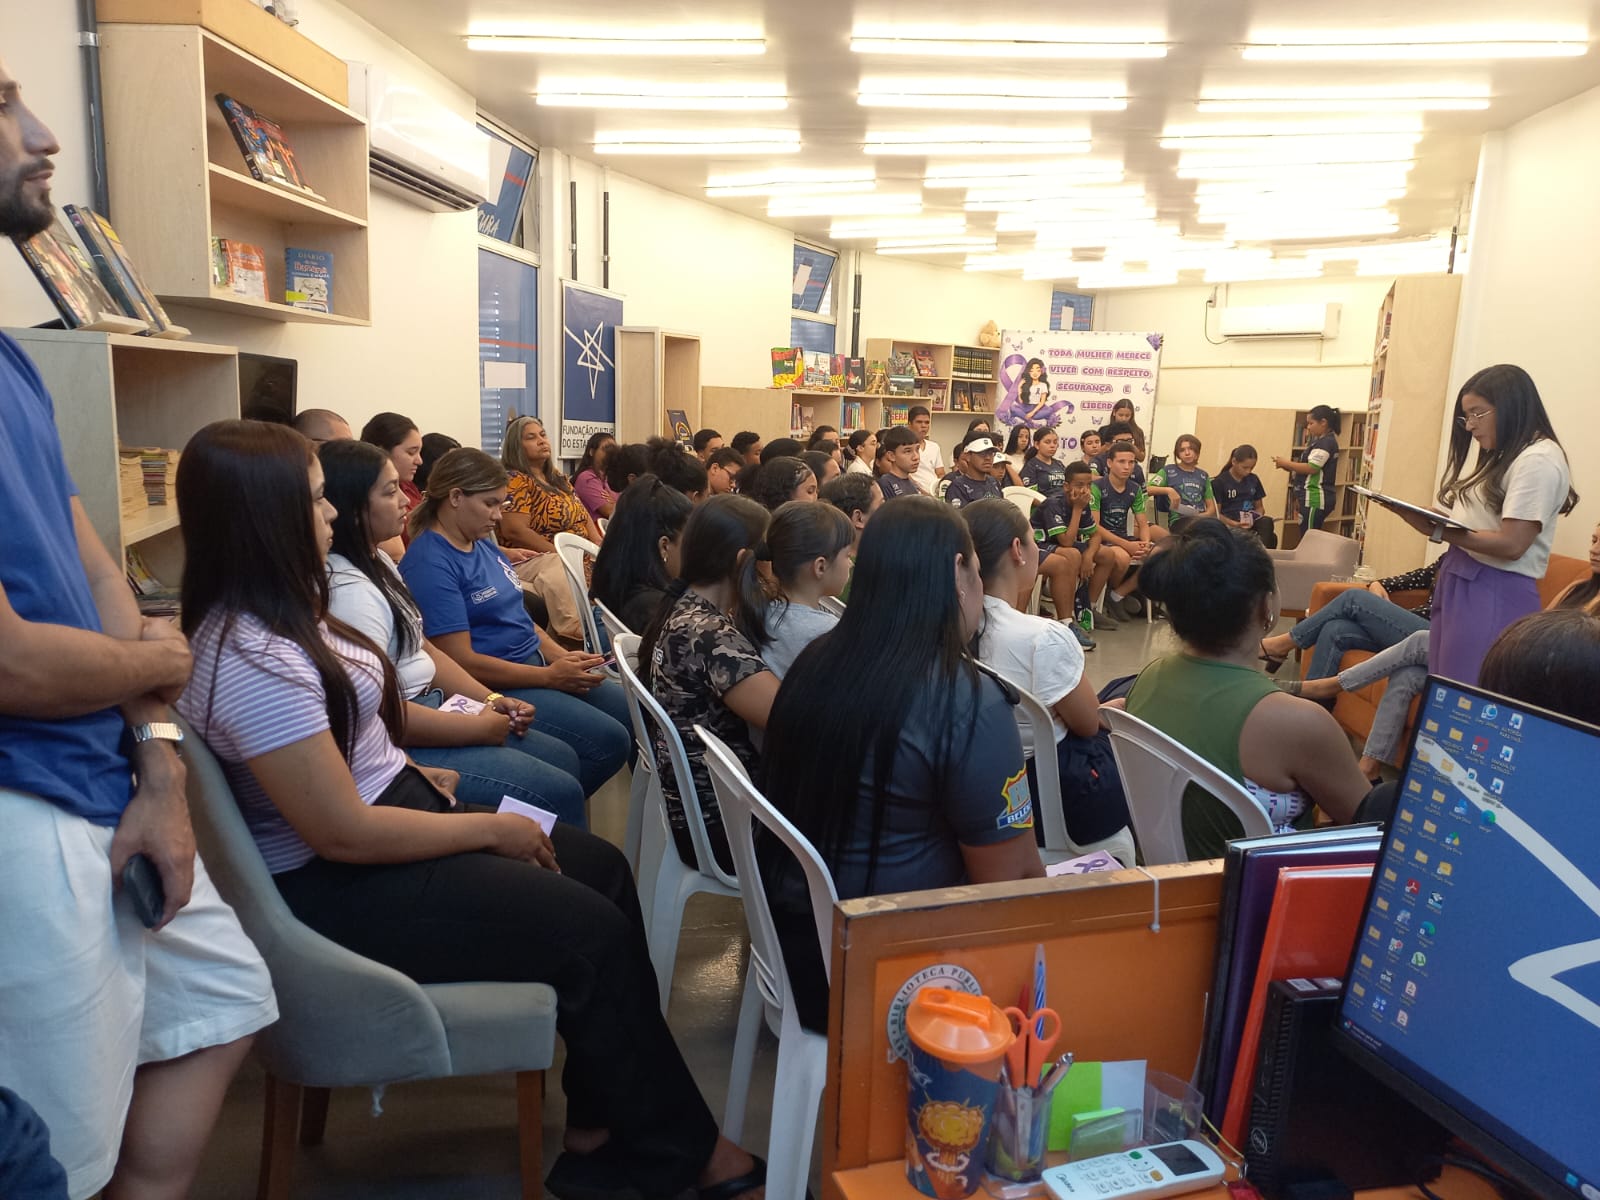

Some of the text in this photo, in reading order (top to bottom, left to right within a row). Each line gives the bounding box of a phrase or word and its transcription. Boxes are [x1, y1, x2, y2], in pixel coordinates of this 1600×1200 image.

[1049, 349, 1151, 360] TODA MULHER MERECE
[1050, 366, 1077, 374] VIVER
[1082, 366, 1104, 375] COM
[1057, 382, 1130, 394] SEGURANÇA E
[1082, 401, 1114, 410] LIBERD
[562, 425, 594, 438] FUNDAÇÃO
[562, 438, 587, 448] DO ESTA
[1227, 489, 1237, 498] 10
[890, 967, 944, 1025] BIBLIOTECA
